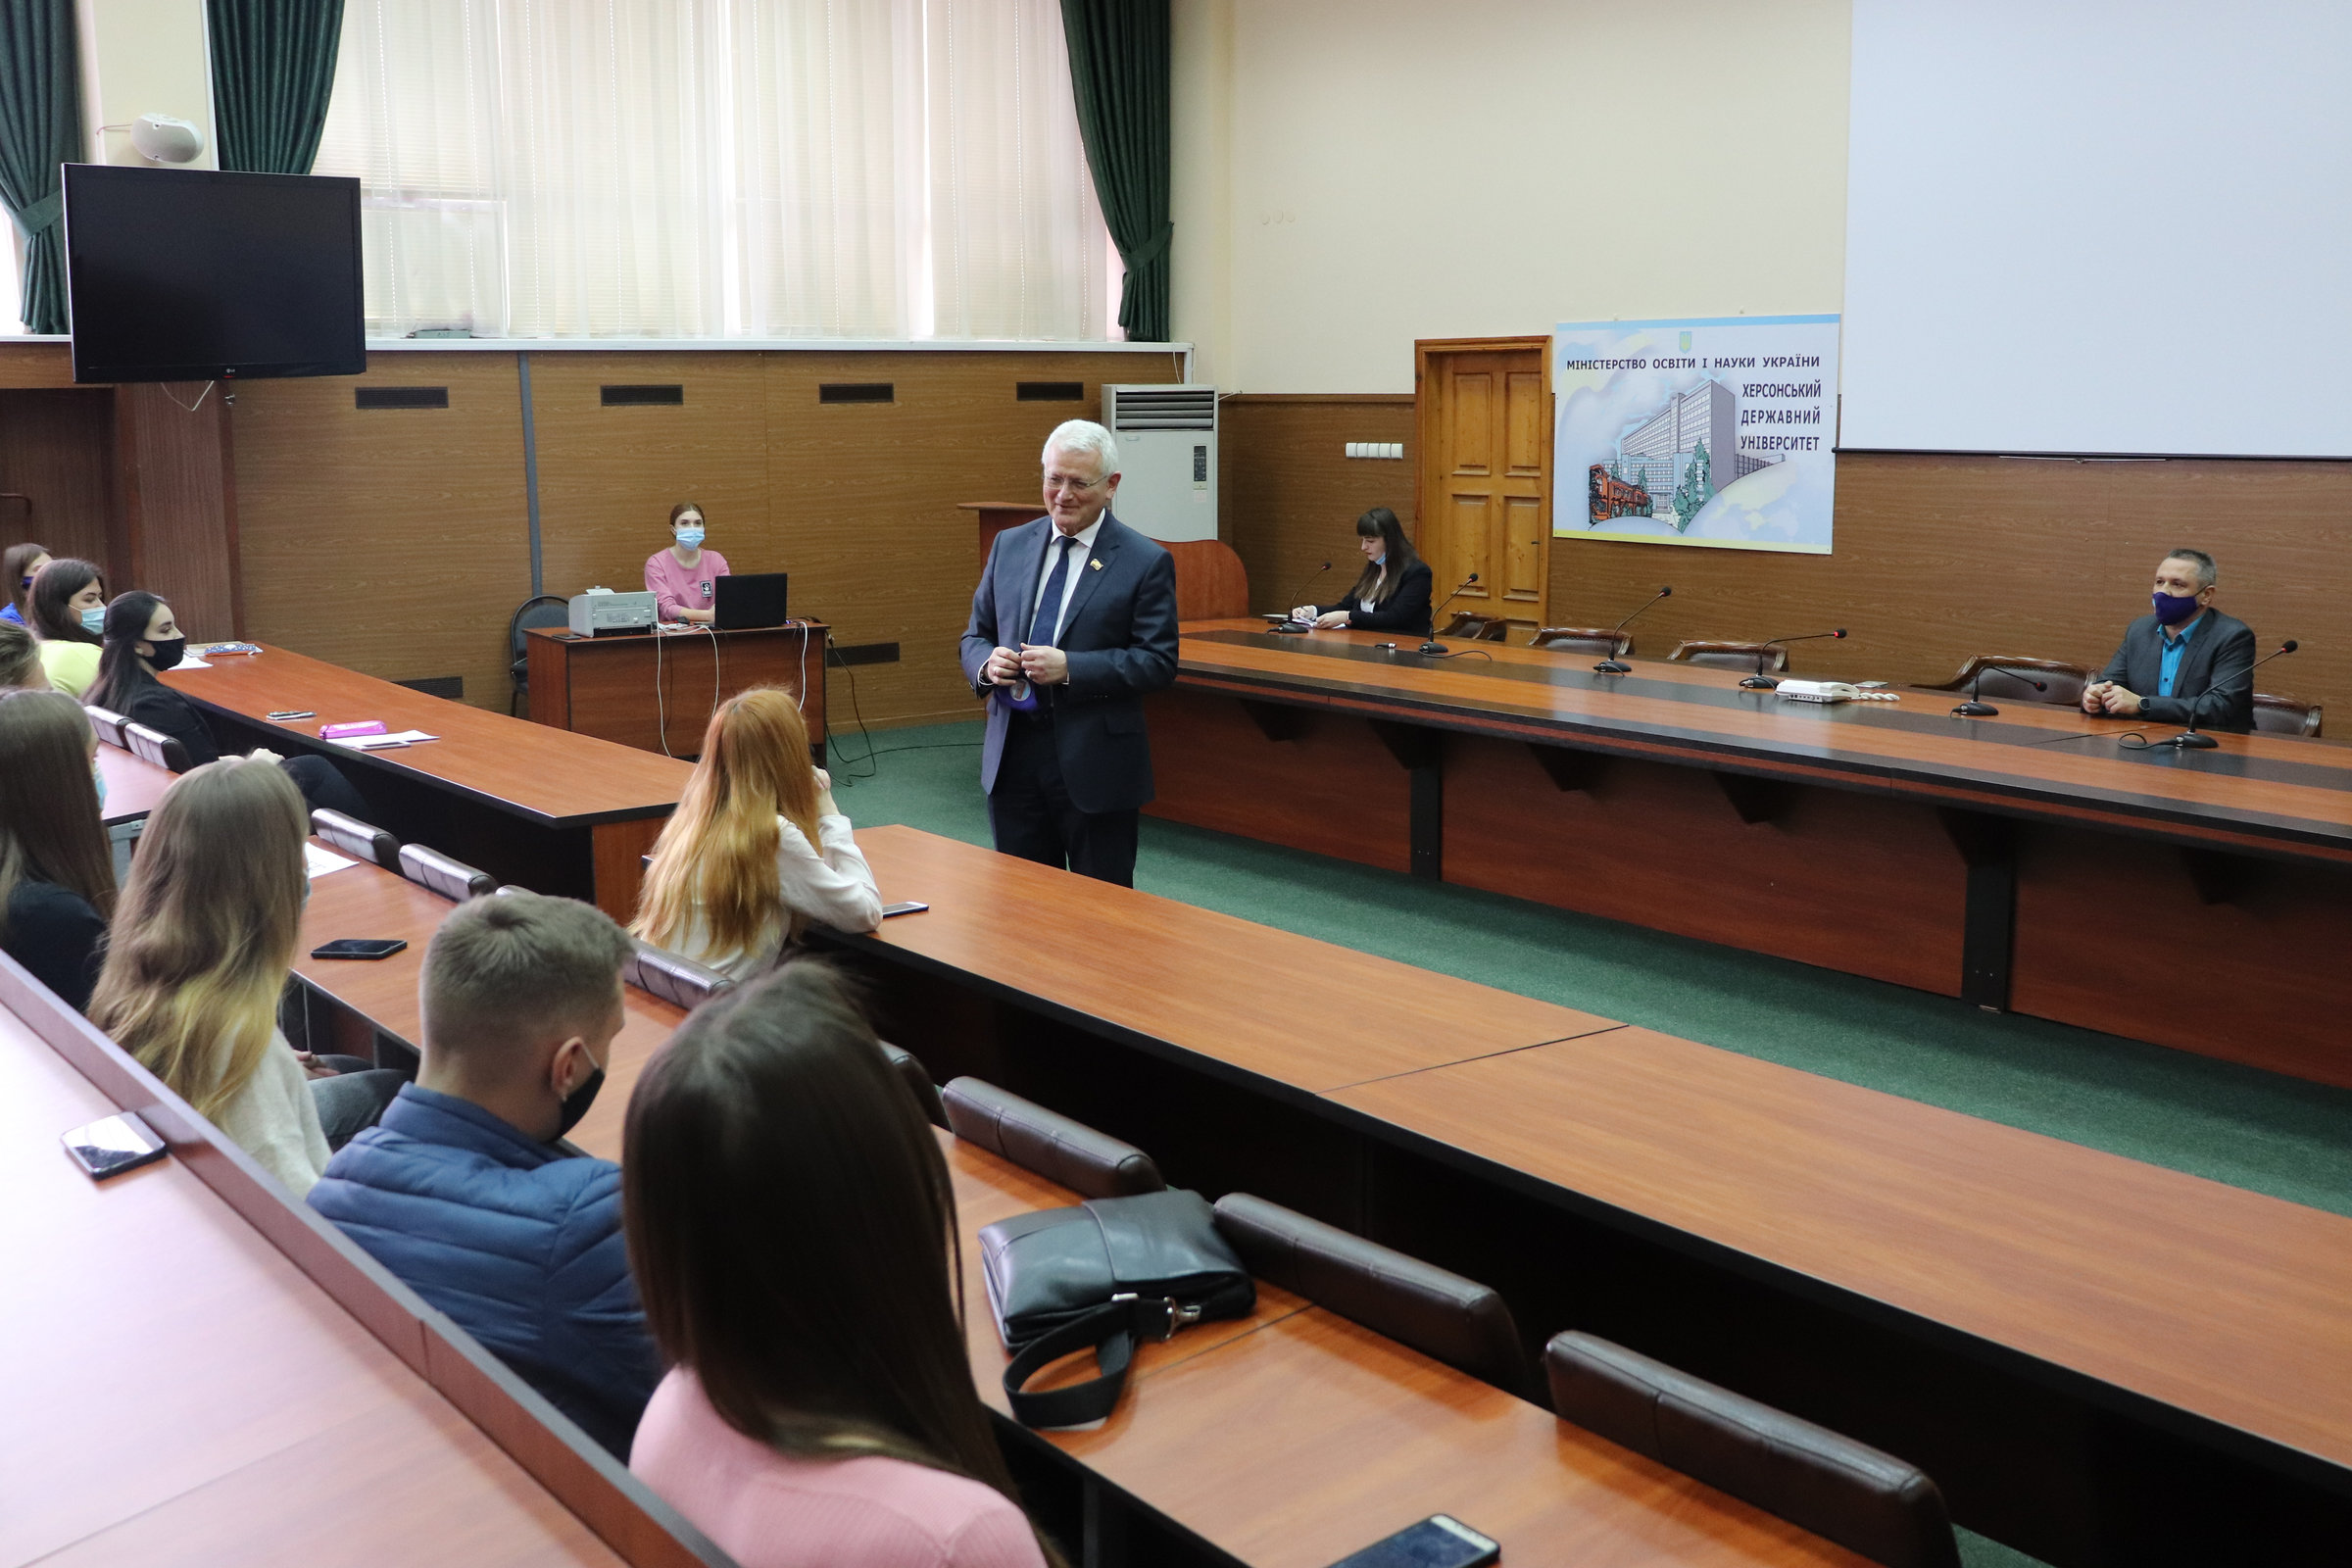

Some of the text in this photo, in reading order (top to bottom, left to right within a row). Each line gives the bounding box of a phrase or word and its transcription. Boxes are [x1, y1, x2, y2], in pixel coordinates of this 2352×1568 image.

[1567, 353, 1820, 370] МІНІСТЕРСТВО ОСВІТИ І НАУКИ УКРАЇНИ
[1741, 378, 1822, 398] ХЕРСОНСЬКИЙ
[1740, 406, 1821, 426] ДЕРЖАВНИЙ
[1740, 435, 1820, 451] УНІВЕРСИТЕТ
